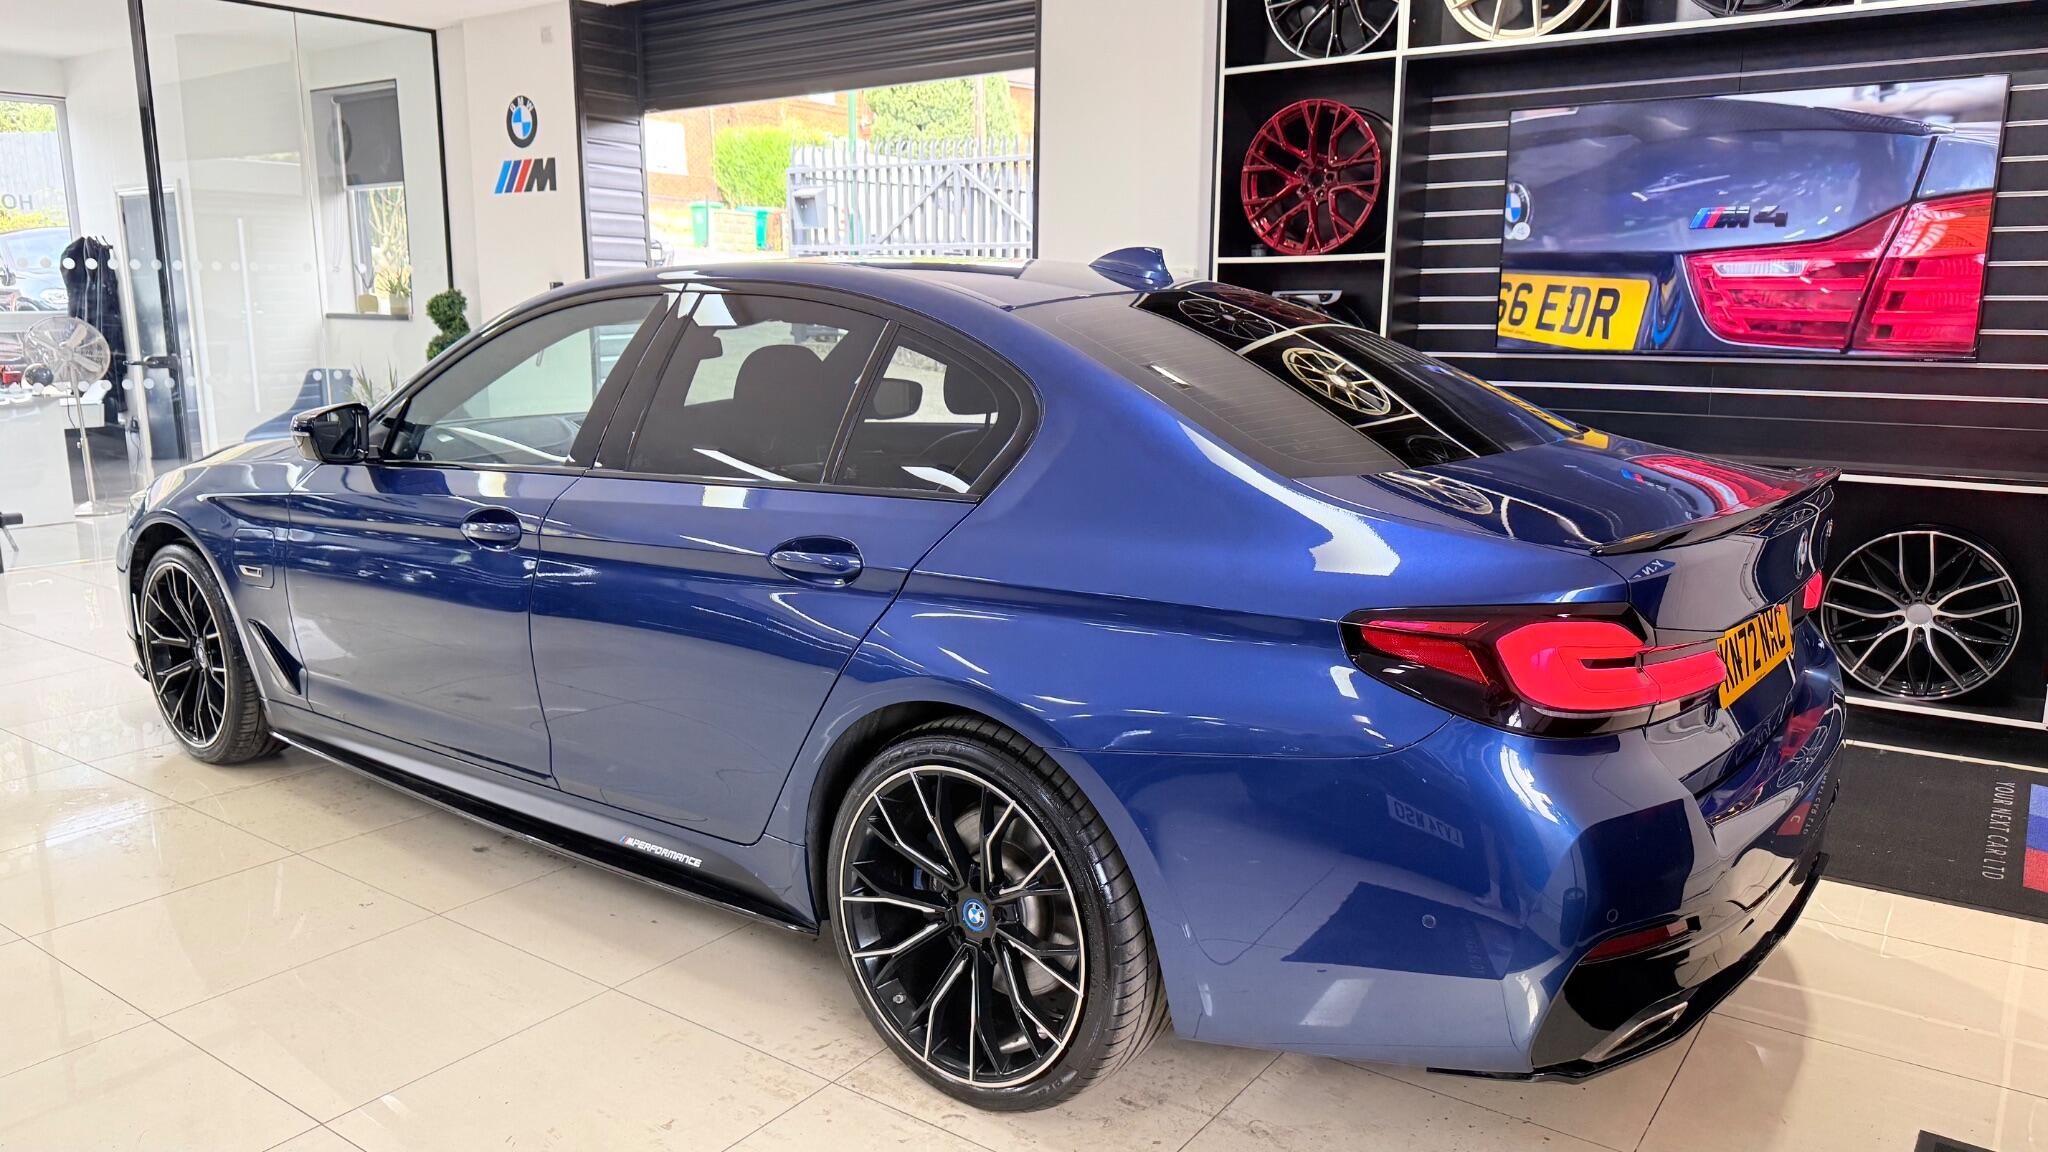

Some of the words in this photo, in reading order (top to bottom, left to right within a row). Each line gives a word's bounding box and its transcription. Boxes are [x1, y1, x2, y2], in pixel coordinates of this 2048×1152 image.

[509, 96, 534, 112] BMW
[1535, 284, 1621, 340] EDR
[1719, 622, 1761, 693] KN72
[1993, 782, 2015, 806] YOUR
[1988, 807, 2012, 833] NEXT
[1985, 834, 2009, 855] CAR
